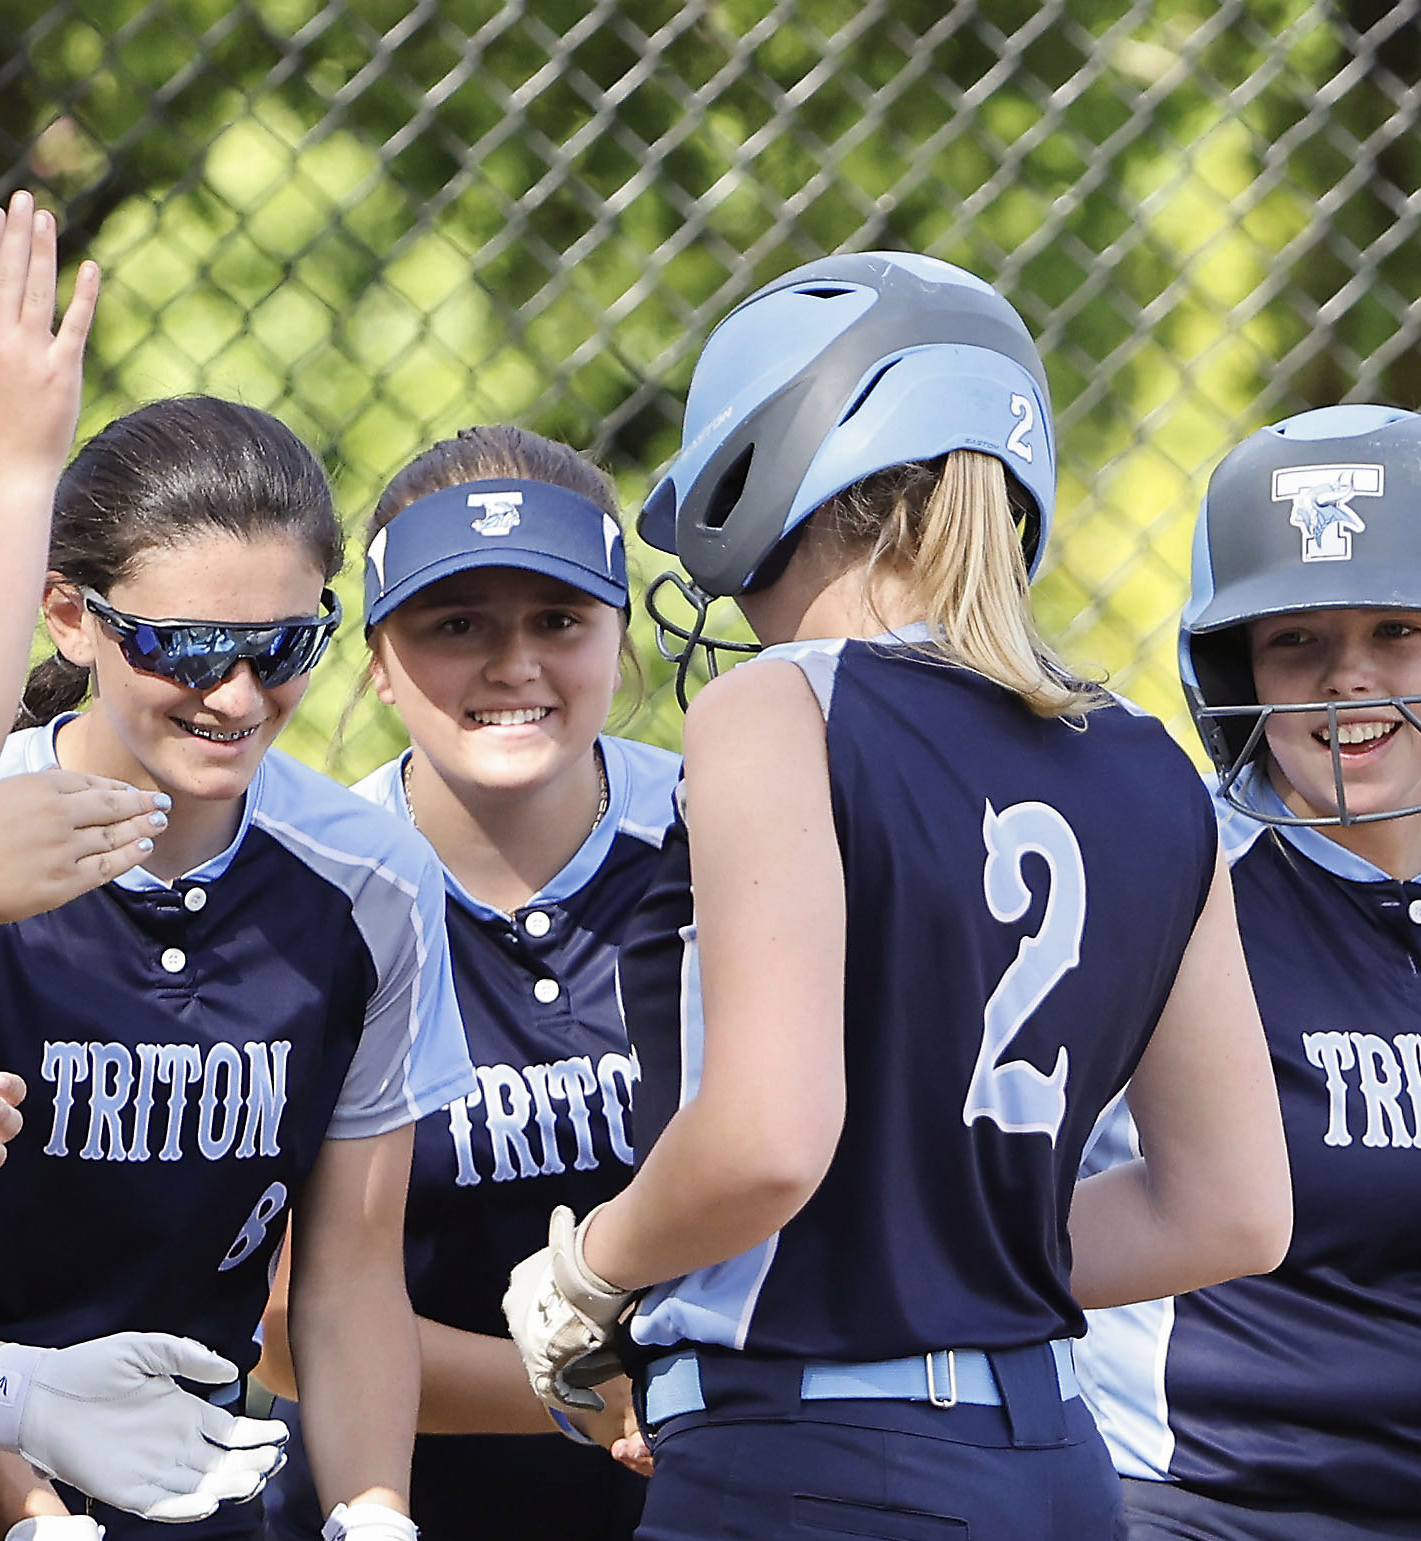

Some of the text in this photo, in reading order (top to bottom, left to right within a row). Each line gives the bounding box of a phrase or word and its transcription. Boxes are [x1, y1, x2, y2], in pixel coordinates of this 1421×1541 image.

[1006, 392, 1034, 464] 2
[963, 797, 1086, 1150] 2
[41, 1039, 292, 1162] TRITON
[441, 1044, 642, 1187] TRITO
